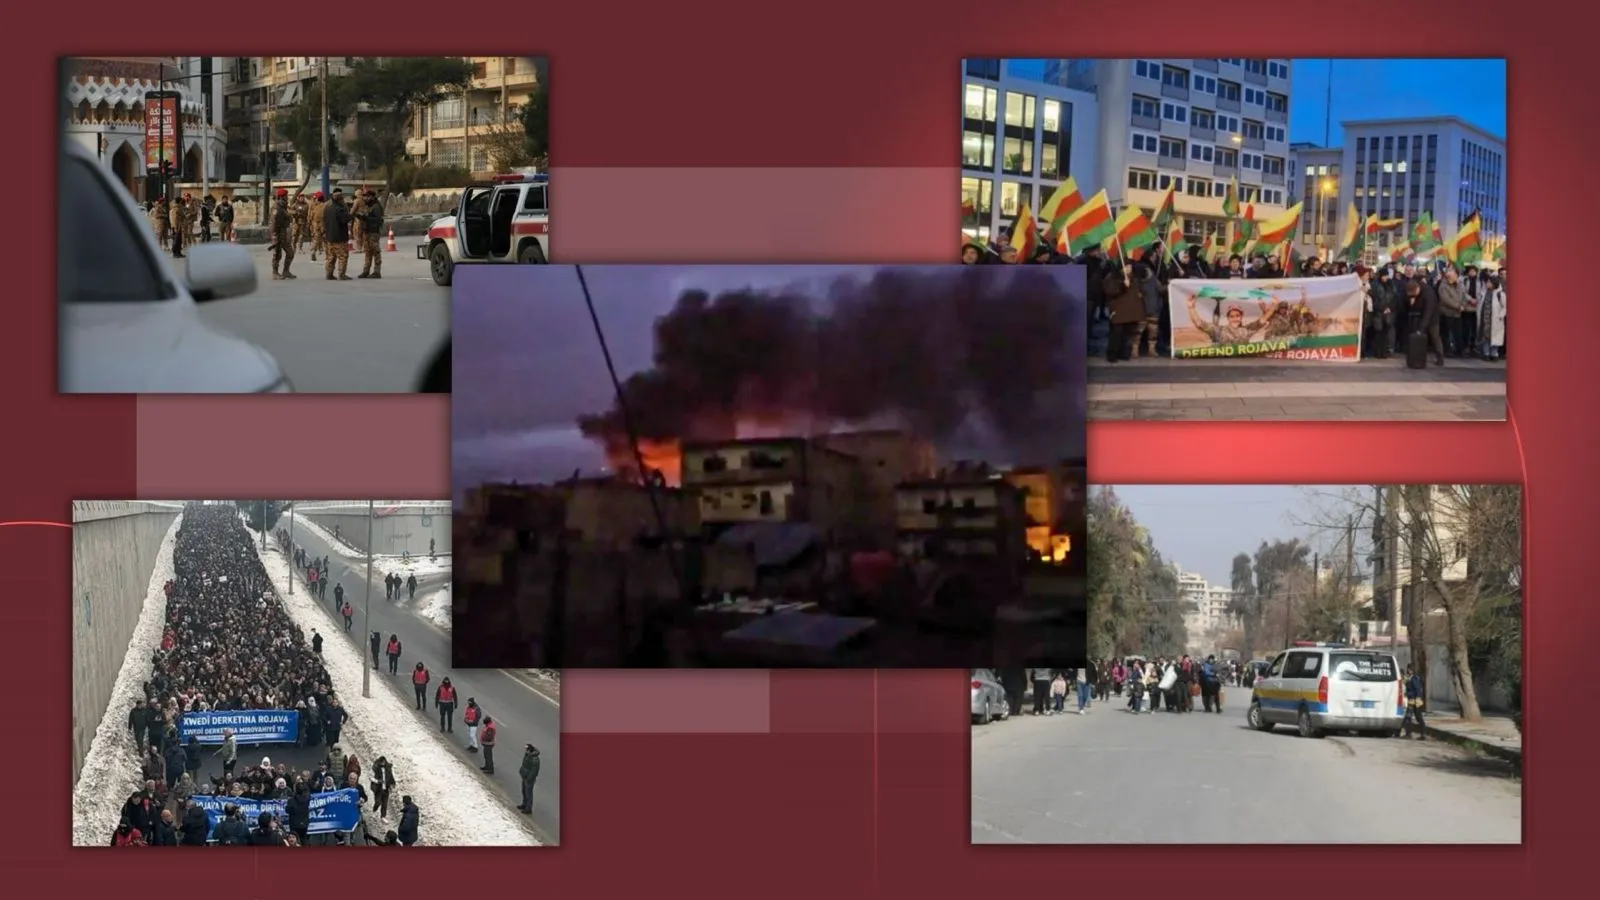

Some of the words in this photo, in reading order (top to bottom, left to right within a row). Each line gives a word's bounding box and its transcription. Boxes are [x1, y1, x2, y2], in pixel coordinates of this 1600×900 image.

[1182, 345, 1233, 357] DEFEND
[1286, 347, 1343, 360] ROJAVA!
[212, 715, 256, 725] DERKETINA
